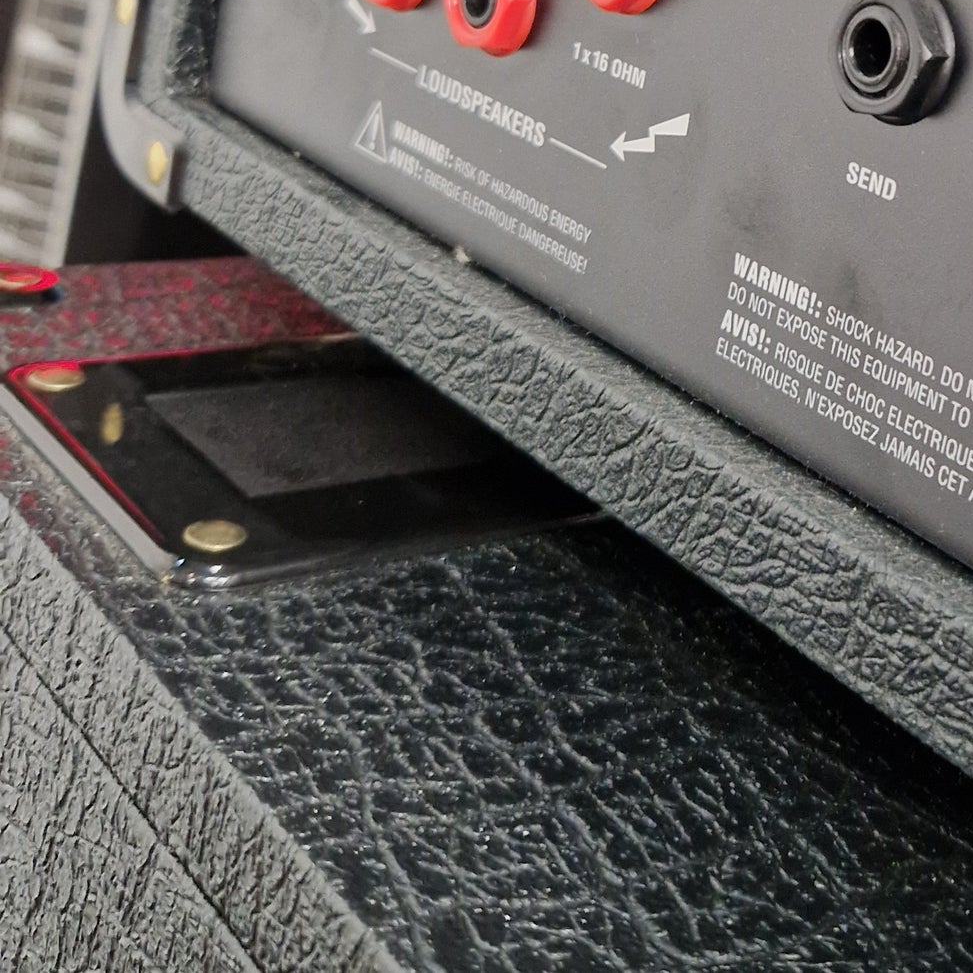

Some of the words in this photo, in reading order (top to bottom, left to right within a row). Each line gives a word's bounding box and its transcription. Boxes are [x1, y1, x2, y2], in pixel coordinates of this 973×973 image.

[418, 64, 548, 148] LOUDSPEAKERS
[611, 58, 647, 90] OHM
[424, 168, 462, 203] ENERGIE
[462, 189, 519, 236] ELECTRIQUE
[518, 222, 588, 275] DANGEREUSE!
[454, 158, 479, 184] RISK
[478, 170, 492, 188] OF
[491, 178, 550, 222] HAZARDOUS
[550, 209, 592, 244] ENERGY
[845, 160, 897, 201] SEND
[727, 281, 747, 306] DO
[748, 292, 776, 320] NOT
[776, 308, 828, 350] EXPOSE
[830, 334, 862, 368] THIS
[862, 354, 949, 414] EQUIPMENT
[951, 400, 971, 428] TO
[774, 341, 824, 384] RISQUE
[824, 369, 849, 397] DE
[846, 382, 887, 419] CHOC
[826, 305, 875, 346] SHOCK
[875, 330, 936, 381] HAZARD.
[940, 365, 964, 393] DO
[715, 336, 801, 405] ELECTRIQUES,
[804, 387, 881, 446] N'EXPOSEZ
[879, 433, 936, 478] JAMAIS
[937, 464, 969, 496] CET
